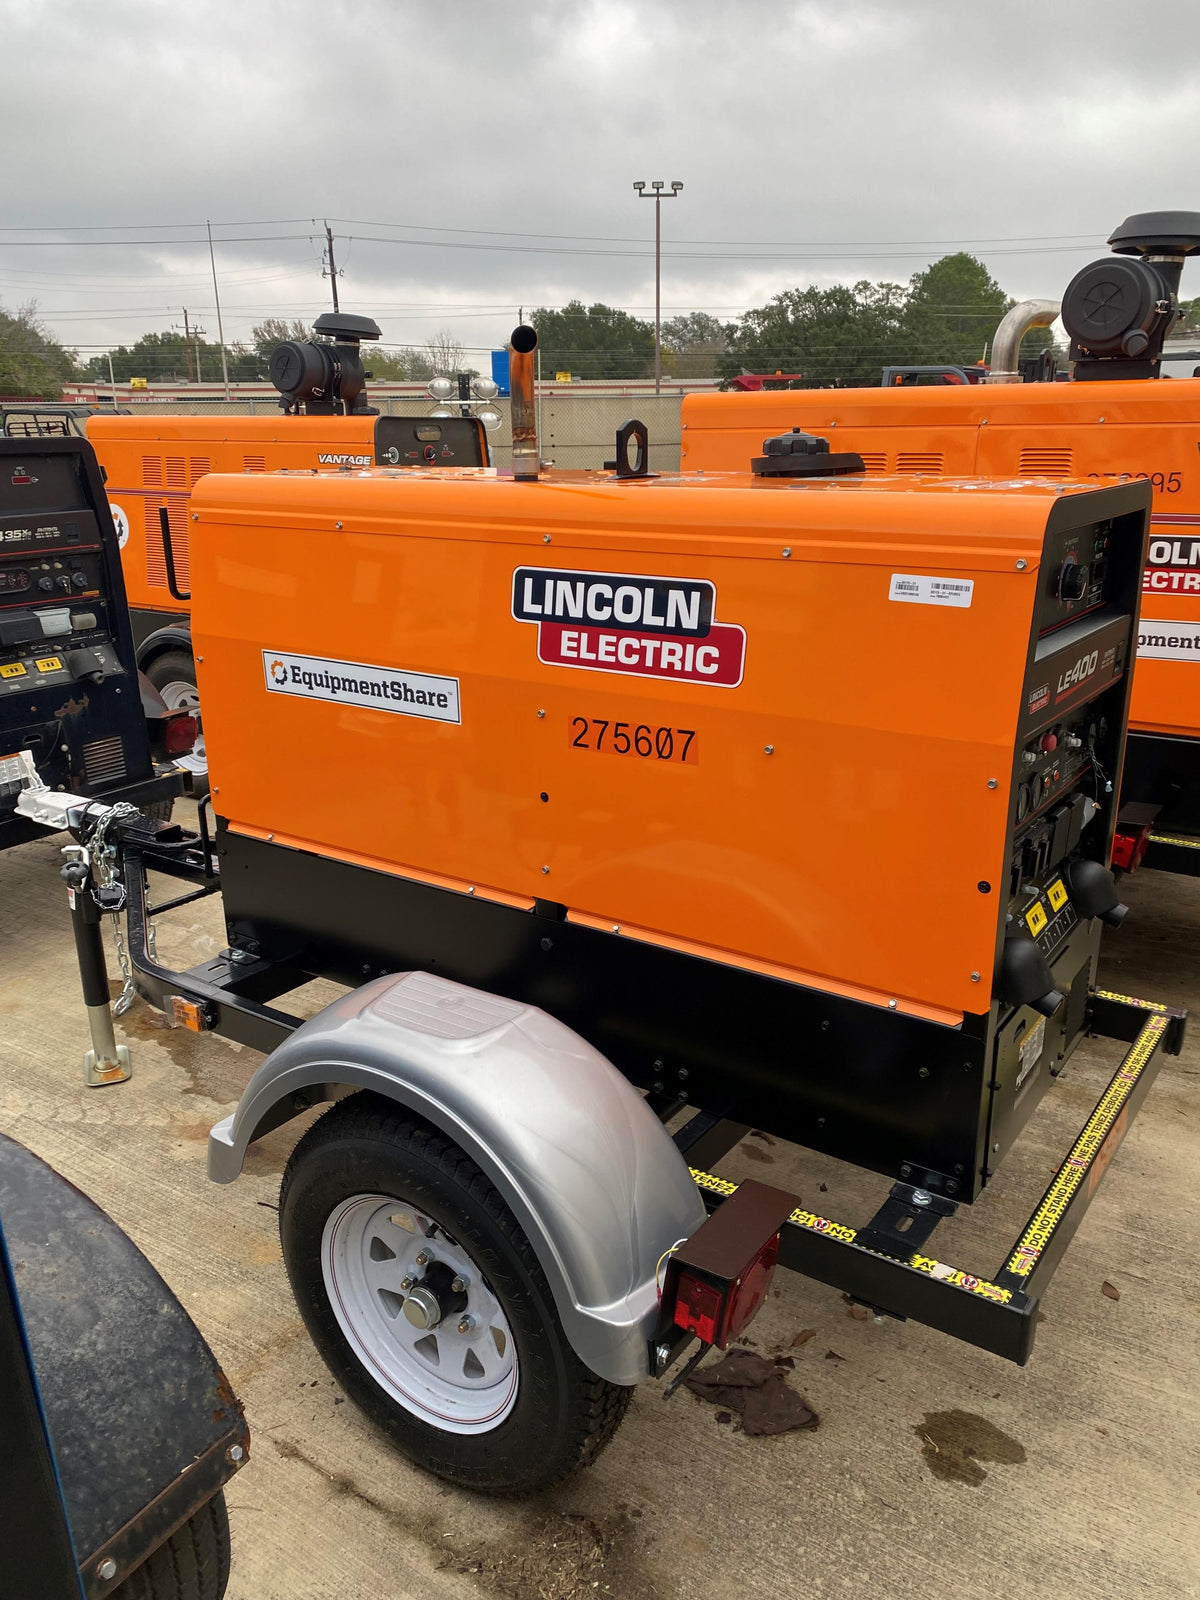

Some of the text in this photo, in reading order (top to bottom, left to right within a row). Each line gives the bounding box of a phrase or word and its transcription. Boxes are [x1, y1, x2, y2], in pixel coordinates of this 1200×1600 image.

[318, 454, 371, 465] VANTAGE
[523, 578, 700, 629] LINCOLN
[560, 630, 720, 674] ELECTRIC
[1057, 650, 1099, 694] LE400
[290, 665, 448, 708] EquipmentShare
[572, 717, 696, 761] 275607
[1077, 1148, 1088, 1159] NE
[1084, 1134, 1097, 1150] PAS
[1092, 1114, 1109, 1135] TENEZ
[1103, 1090, 1122, 1114] DEBOUT
[693, 1173, 811, 1223] TENEZ ICI
[1029, 1167, 1079, 1246] DO NOT STAND HERE
[831, 1227, 853, 1239] NO
